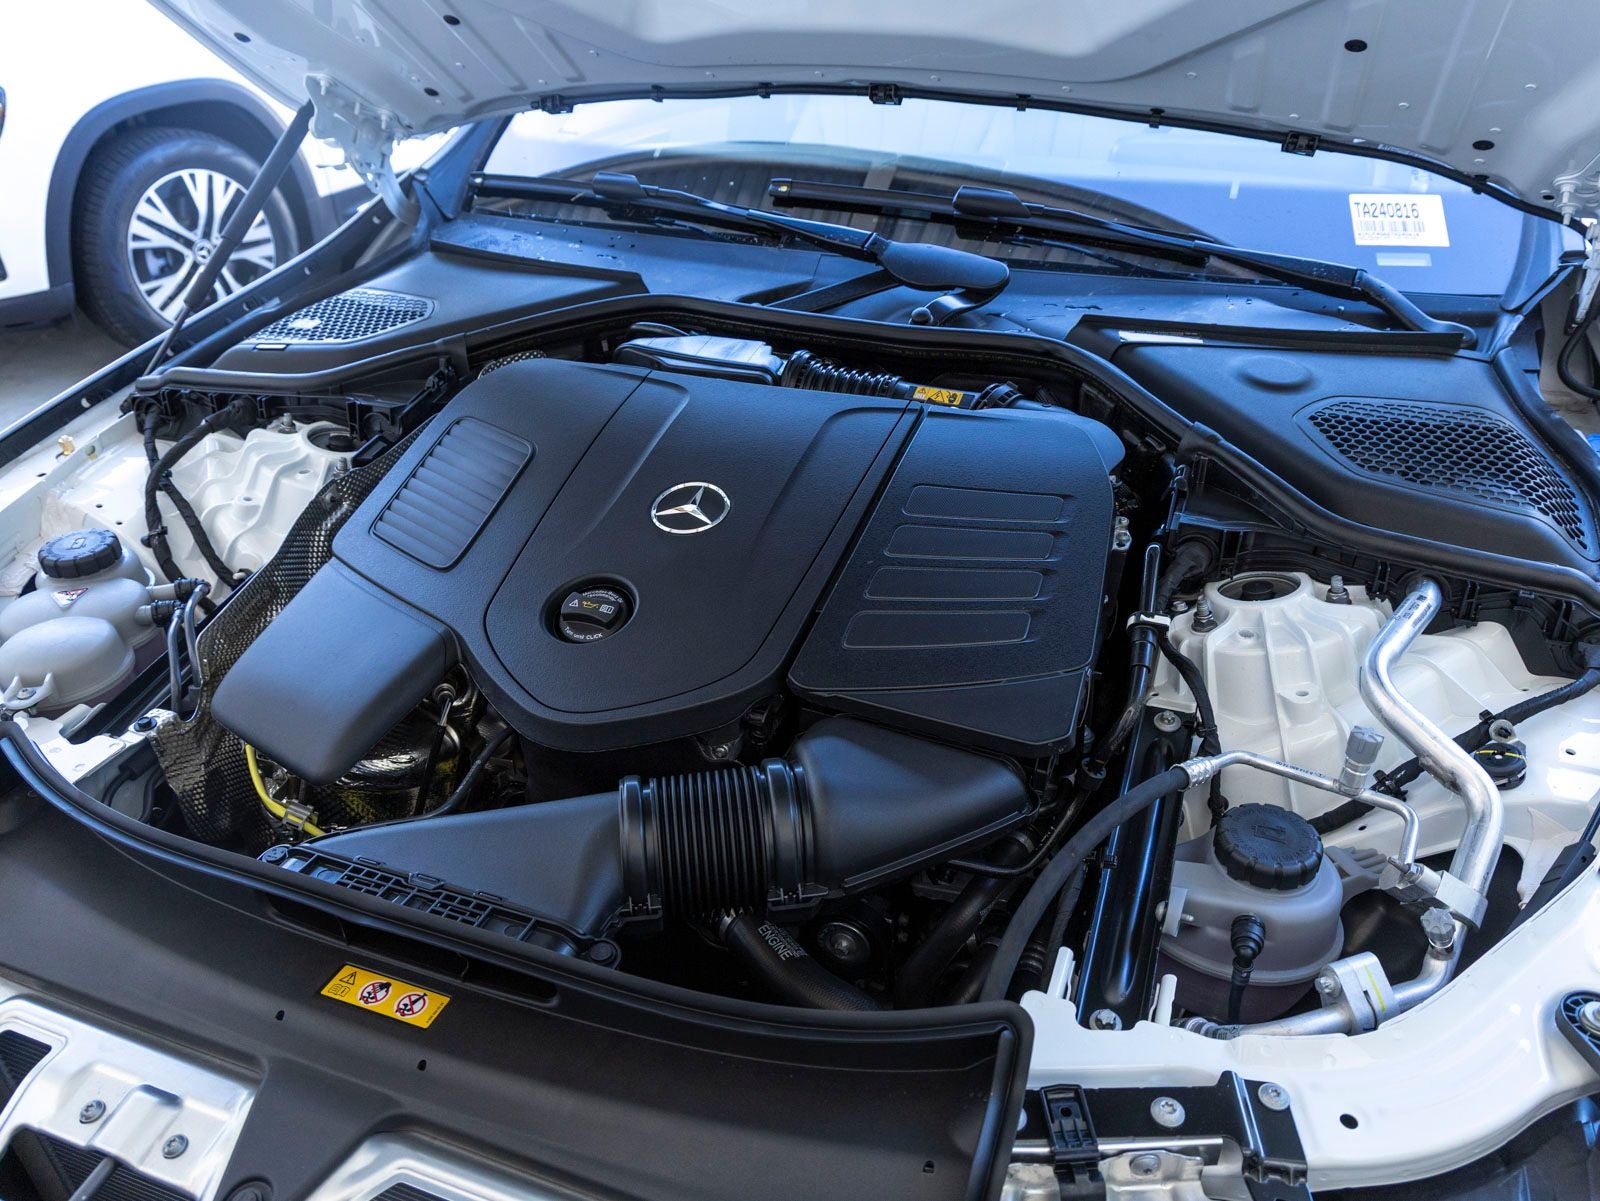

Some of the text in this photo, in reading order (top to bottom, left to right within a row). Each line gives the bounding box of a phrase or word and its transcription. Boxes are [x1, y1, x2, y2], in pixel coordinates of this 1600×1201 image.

[1353, 202, 1420, 219] TA240816
[564, 626, 573, 636] Turn
[757, 924, 793, 961] ENGINE
